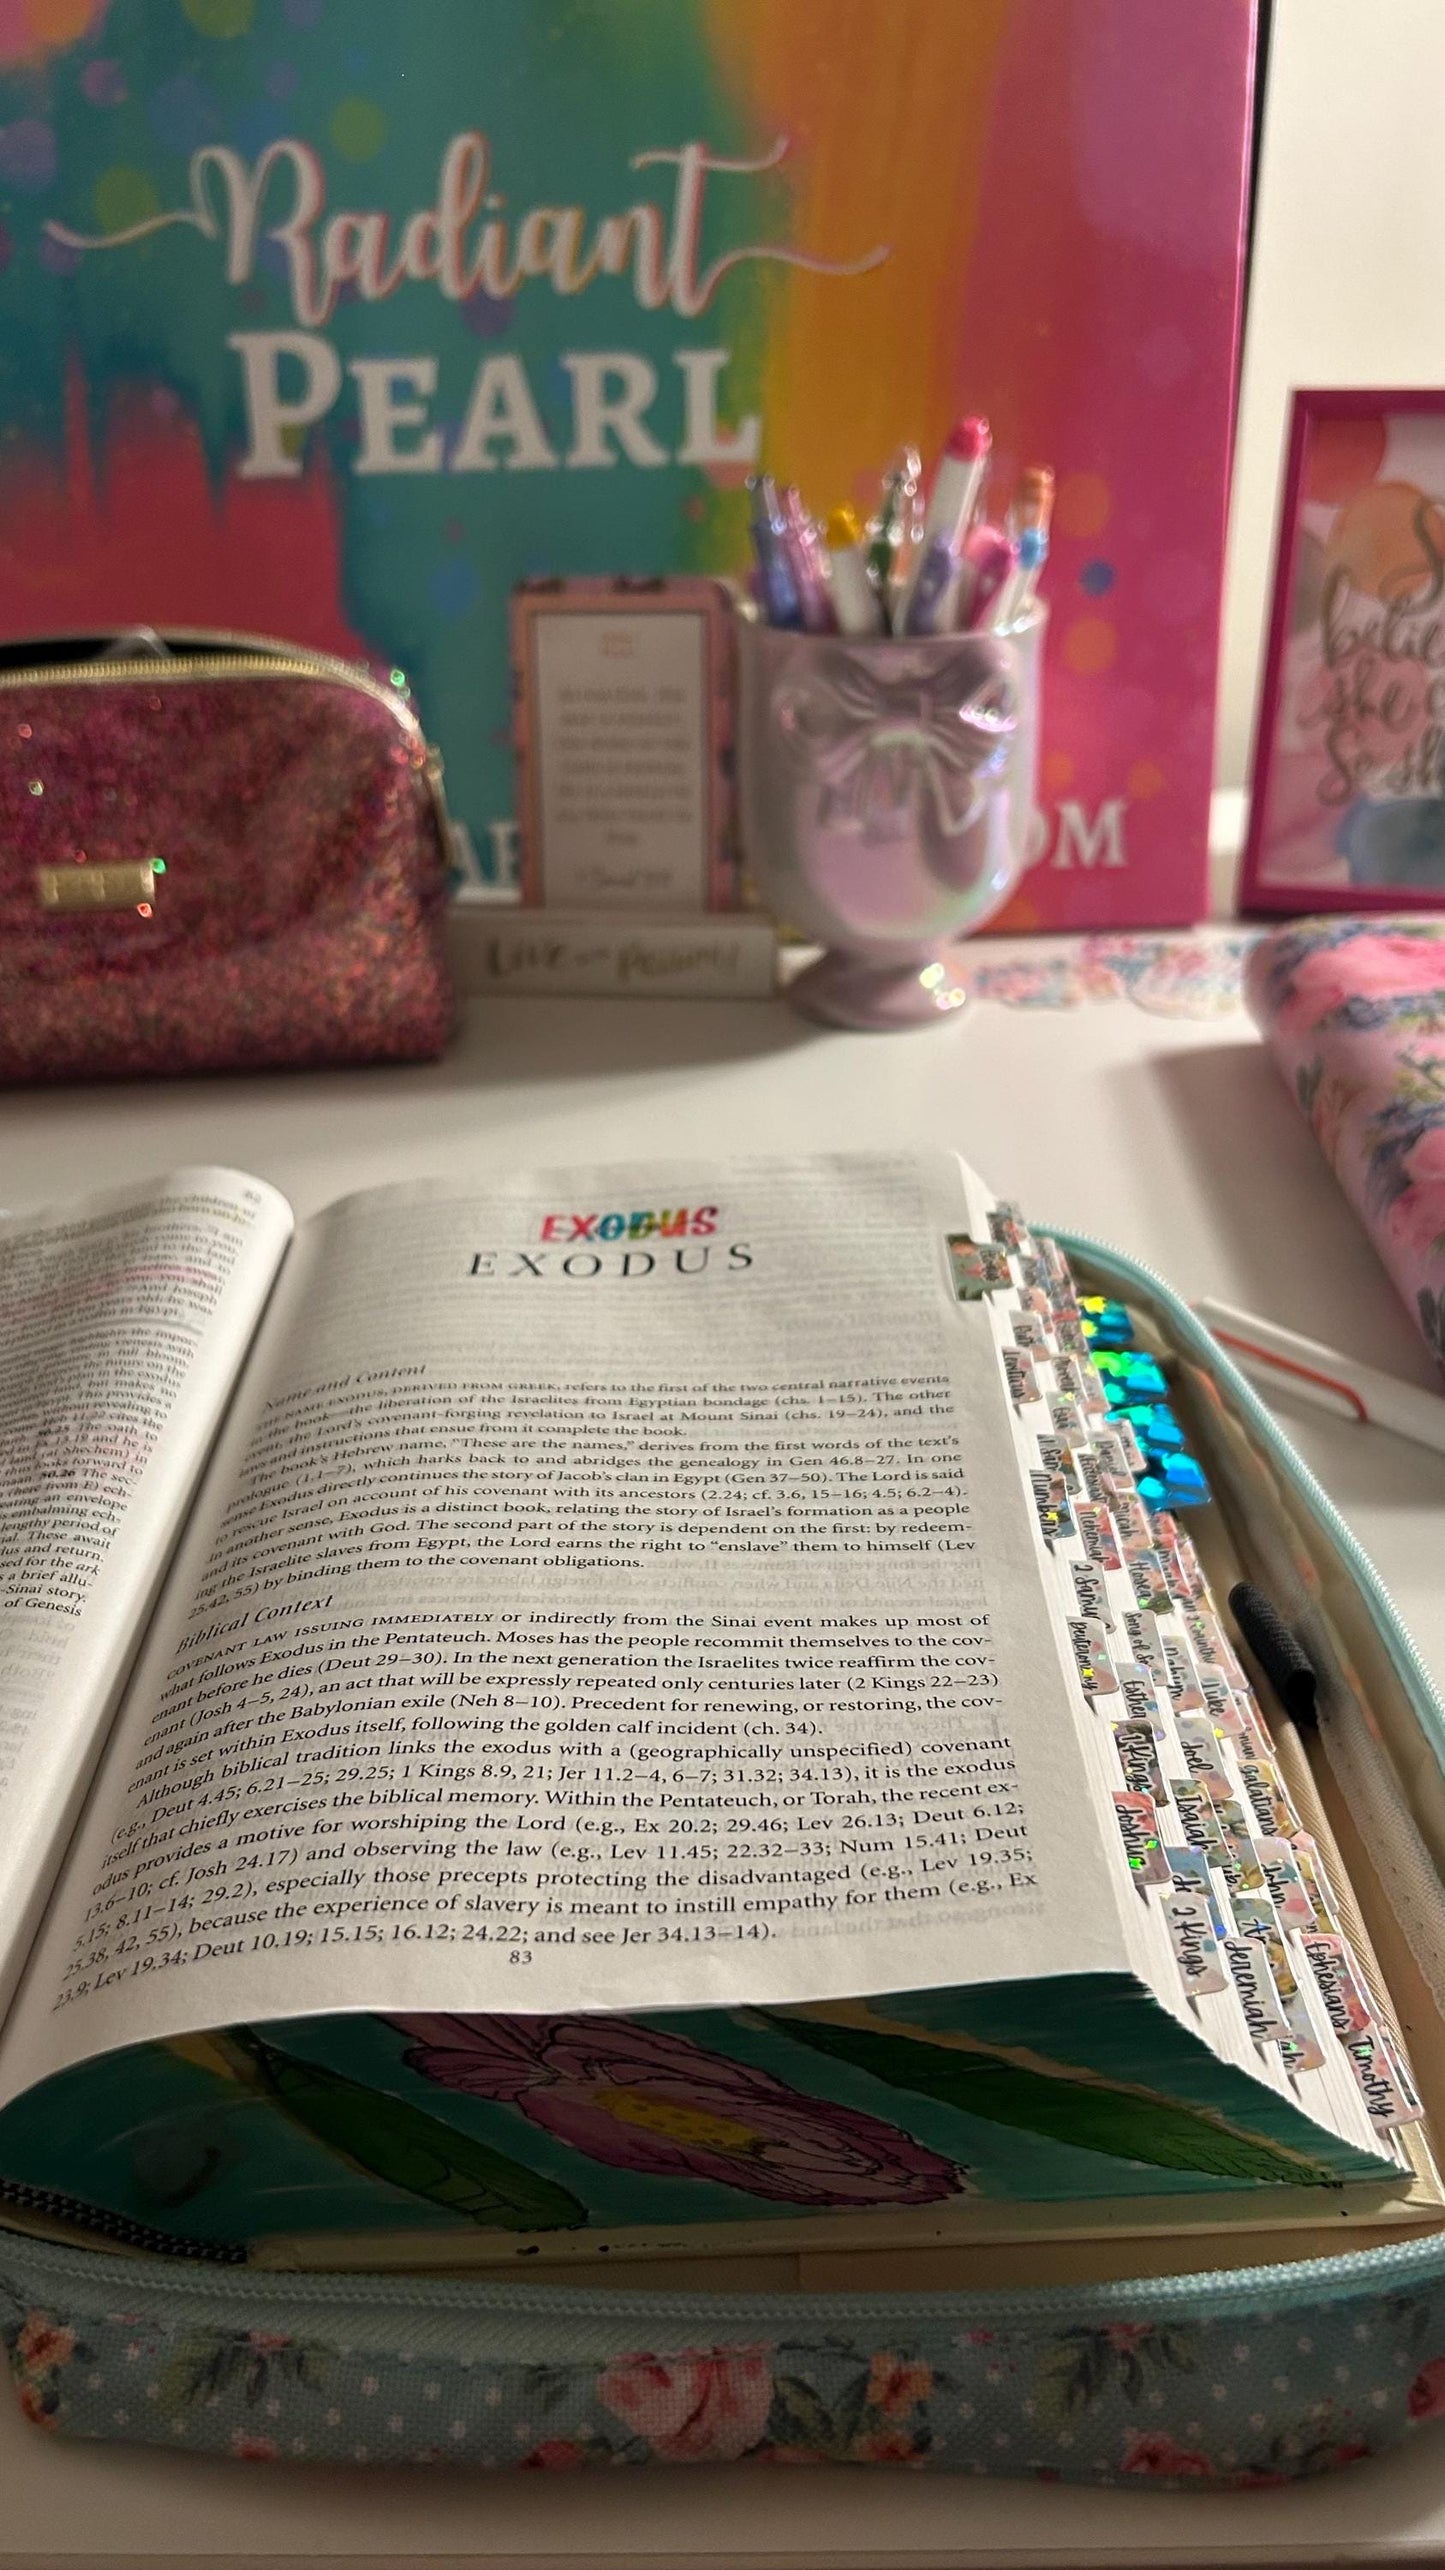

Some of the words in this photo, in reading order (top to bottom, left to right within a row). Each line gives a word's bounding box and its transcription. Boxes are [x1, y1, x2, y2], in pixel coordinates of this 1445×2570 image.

[43, 129, 891, 326] Radiant
[228, 330, 762, 482] PEARL
[540, 1206, 719, 1243] EXODUS
[467, 1243, 754, 1279] EXODUS
[20, 1569, 58, 1581] brief
[188, 1594, 230, 1620] 25.42,
[233, 1582, 259, 1599] 55)
[263, 1578, 284, 1590] by
[286, 1564, 352, 1584] binding
[356, 1559, 400, 1571] them
[406, 1557, 423, 1566] to
[428, 1554, 456, 1565] the
[460, 1556, 538, 1566] covenant
[543, 1555, 644, 1569] obligations.
[194, 1584, 218, 1600] ing
[221, 1573, 245, 1588] the
[247, 1554, 312, 1578] Israelite
[315, 1545, 363, 1560] slaves
[368, 1540, 410, 1552] from
[415, 1537, 471, 1550] Egypt,
[477, 1536, 504, 1547] the
[509, 1537, 551, 1548] Lord
[556, 1541, 602, 1549] earns
[608, 1538, 635, 1549] the
[640, 1539, 682, 1553] right
[688, 1542, 706, 1551] to
[710, 1540, 788, 1552] “enslave”
[793, 1541, 838, 1552] them
[843, 1543, 861, 1551] to
[866, 1539, 932, 1551] himself
[937, 1539, 975, 1552] (Lev
[4, 1596, 24, 1609] of
[25, 1597, 82, 1617] Genesis
[175, 1611, 250, 1656] Biblical
[254, 1595, 333, 1626] Context
[167, 1641, 248, 1680] COVENANT
[250, 1631, 288, 1648] LAW
[294, 1618, 364, 1637] ISSUING
[371, 1614, 498, 1630] IMMEDIATELY
[501, 1614, 522, 1623] or
[528, 1611, 617, 1628] indirectly
[622, 1613, 672, 1626] from
[676, 1614, 704, 1627] the
[711, 1615, 757, 1628] Sinai
[764, 1617, 813, 1628] event
[819, 1615, 877, 1627] makes
[885, 1618, 909, 1630] up
[916, 1617, 963, 1627] most
[970, 1614, 990, 1626] of
[1122, 1680, 1149, 1720] Esther
[136, 1764, 214, 1809] Although
[221, 1751, 289, 1779] biblical
[294, 1741, 381, 1763] tradition
[387, 1734, 442, 1755] links
[444, 1735, 475, 1754] the
[482, 1740, 551, 1755] exodus
[559, 1741, 602, 1758] with
[610, 1747, 621, 1757] a
[630, 1743, 783, 1763] (geographically
[790, 1741, 912, 1761] unspecified)
[921, 1737, 1011, 1754] covenant
[1179, 1741, 1215, 1775] Joel
[92, 1869, 130, 1896] odus
[132, 1842, 212, 1880] provides
[216, 1838, 228, 1850] a
[235, 1824, 305, 1846] motive
[311, 1818, 343, 1835] for
[350, 1813, 468, 1835] worshiping
[475, 1813, 508, 1829] the
[516, 1815, 565, 1831] Lord
[576, 1816, 625, 1837] (e.g.,
[634, 1818, 660, 1833] Ex
[668, 1819, 717, 1835] 20.2;
[727, 1818, 788, 1833] 29.46;
[797, 1817, 833, 1831] Lev
[842, 1813, 904, 1829] 26.13;
[912, 1809, 964, 1824] Deut
[973, 1802, 1024, 1818] 6.12;
[1174, 1794, 1218, 1853] Isaiah
[63, 1947, 109, 1981] 25.38,
[115, 1936, 140, 1955] 42,
[145, 1922, 182, 1945] 55),
[188, 1910, 268, 1934] because
[274, 1901, 307, 1919] the
[313, 1895, 429, 1919] experience
[435, 1893, 462, 1910] of
[464, 1894, 540, 1917] slavery
[546, 1897, 562, 1914] is
[569, 1901, 639, 1915] meant
[646, 1901, 667, 1915] to
[675, 1896, 736, 1914] instill
[743, 1892, 838, 1915] empathy
[845, 1889, 877, 1906] for
[884, 1885, 940, 1902] them
[949, 1879, 1002, 1896] (e.g.,
[1009, 1872, 1038, 1887] Ex
[73, 1922, 111, 1952] 5.15;
[116, 1894, 195, 1930] 8.11–14;
[201, 1880, 257, 1904] 29.2),
[265, 1868, 366, 1895] especially
[374, 1867, 430, 1883] those
[437, 1870, 527, 1888] precepts
[536, 1871, 647, 1892] protecting
[656, 1870, 690, 1886] the
[698, 1864, 851, 1886] disadvantaged
[861, 1863, 913, 1881] (e.g.,
[920, 1858, 958, 1873] Lev
[970, 1848, 1032, 1866] 19.35;
[1171, 1906, 1197, 1917] 2
[509, 1950, 532, 1965] 83
[1173, 1922, 1208, 1977] Kings
[1223, 1941, 1278, 2040] Jeremiah
[1305, 1942, 1351, 2031] Ephesians
[1348, 2035, 1396, 2118] Timothy
